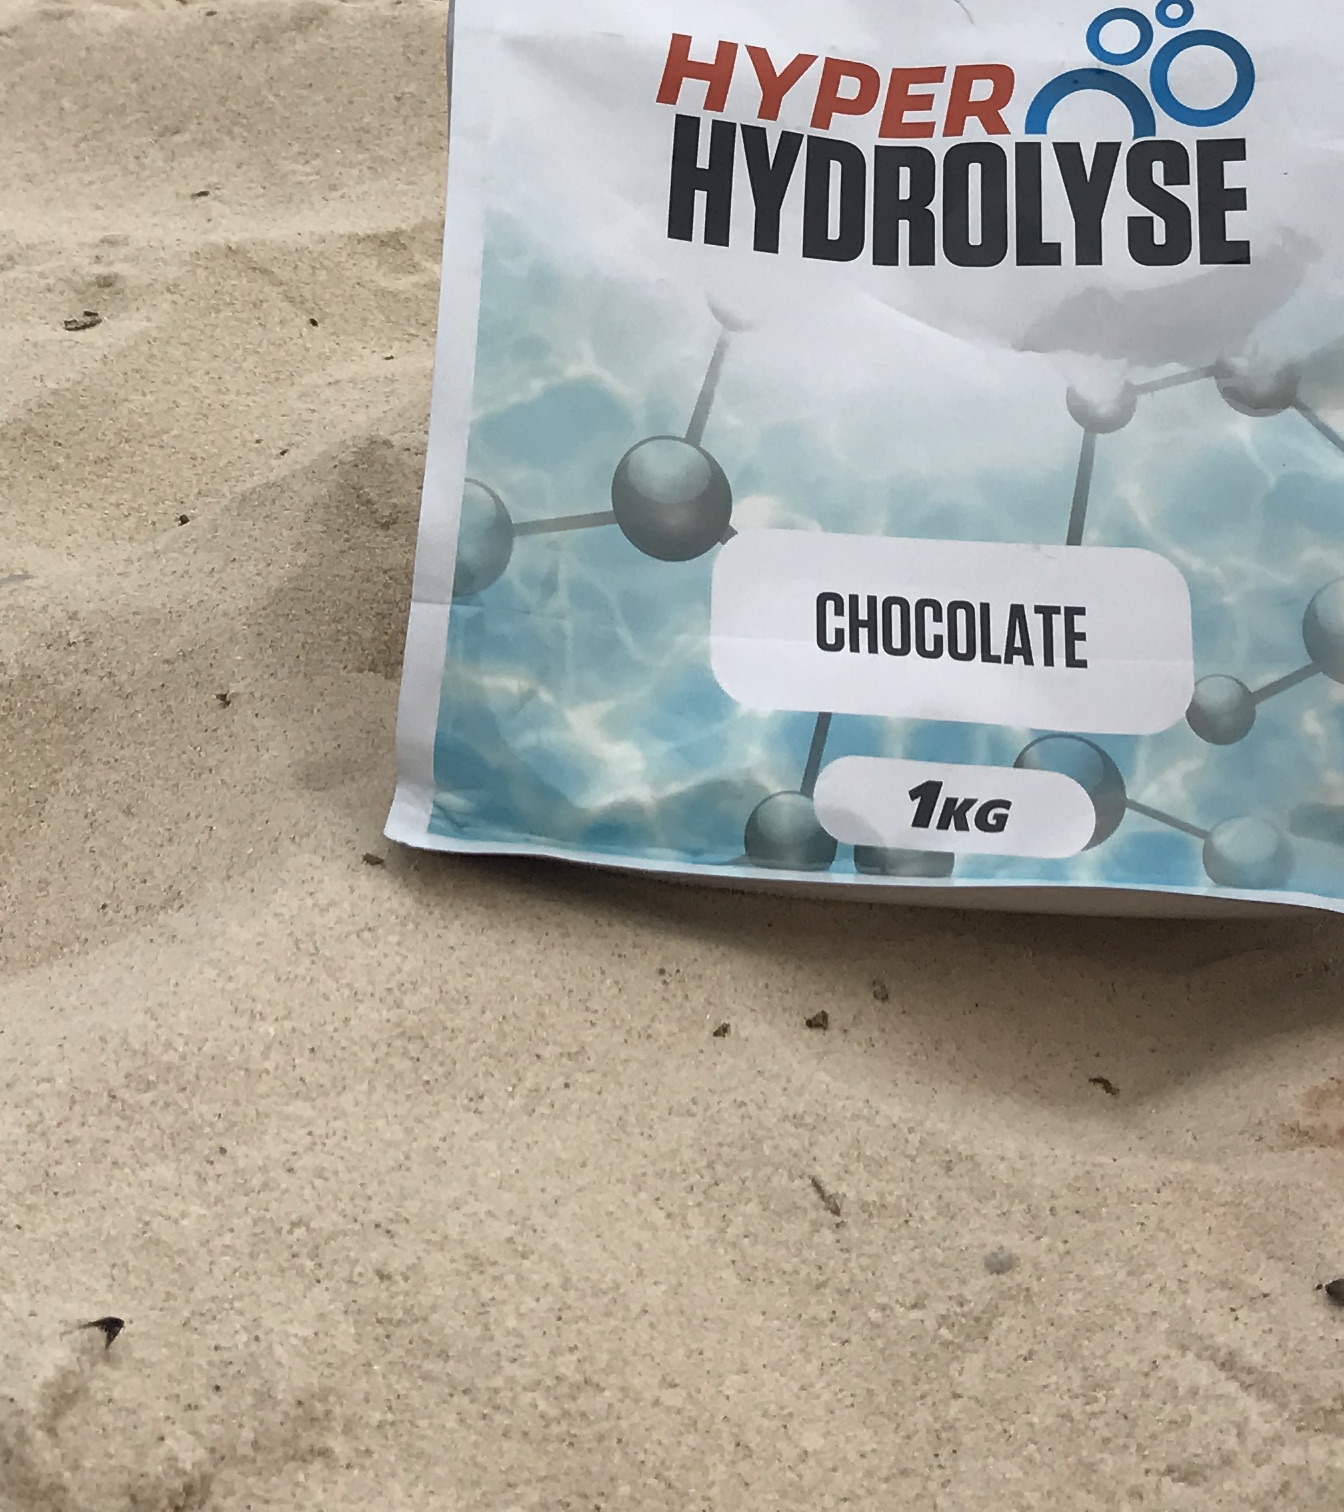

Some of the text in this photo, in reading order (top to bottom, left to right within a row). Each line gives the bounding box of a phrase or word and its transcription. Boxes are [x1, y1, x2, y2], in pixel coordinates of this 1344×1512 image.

[656, 33, 1014, 138] HYPER
[667, 114, 1251, 266] HYDROLYSE
[815, 591, 1087, 669] CHOCOLATE
[907, 780, 1012, 833] 1KG
